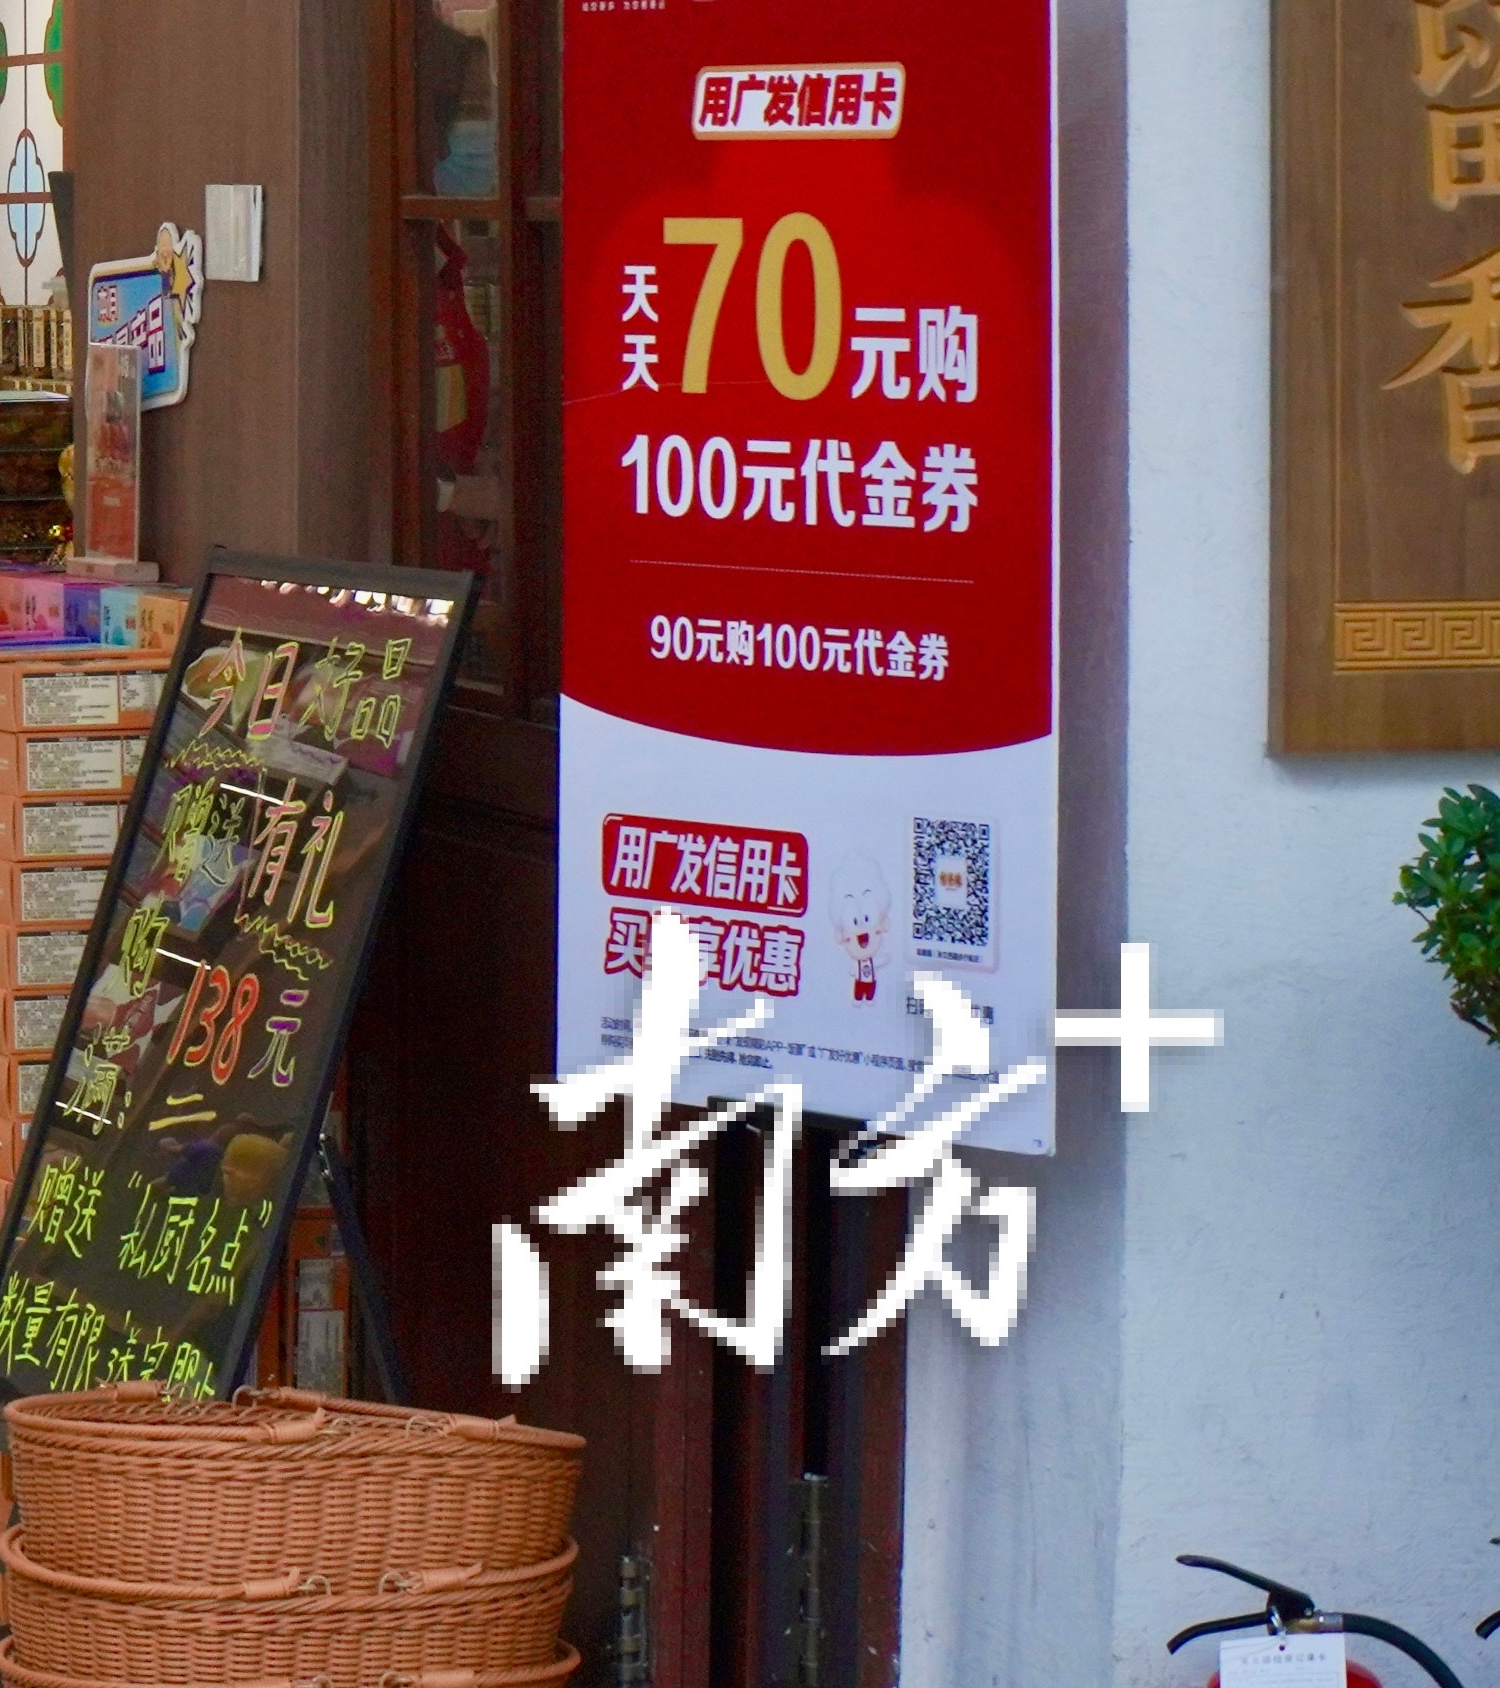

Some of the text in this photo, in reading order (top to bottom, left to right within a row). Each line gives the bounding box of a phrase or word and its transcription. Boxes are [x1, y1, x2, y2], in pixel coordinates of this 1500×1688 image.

[698, 71, 897, 128] 用广发信用卡
[621, 265, 659, 392] 天天
[662, 211, 979, 404] 70元购
[621, 433, 979, 532] 100元代金券
[650, 614, 949, 682] 90元购100元代金券
[611, 826, 803, 907] 用广发信用卡
[607, 911, 803, 996] 买享优惠
